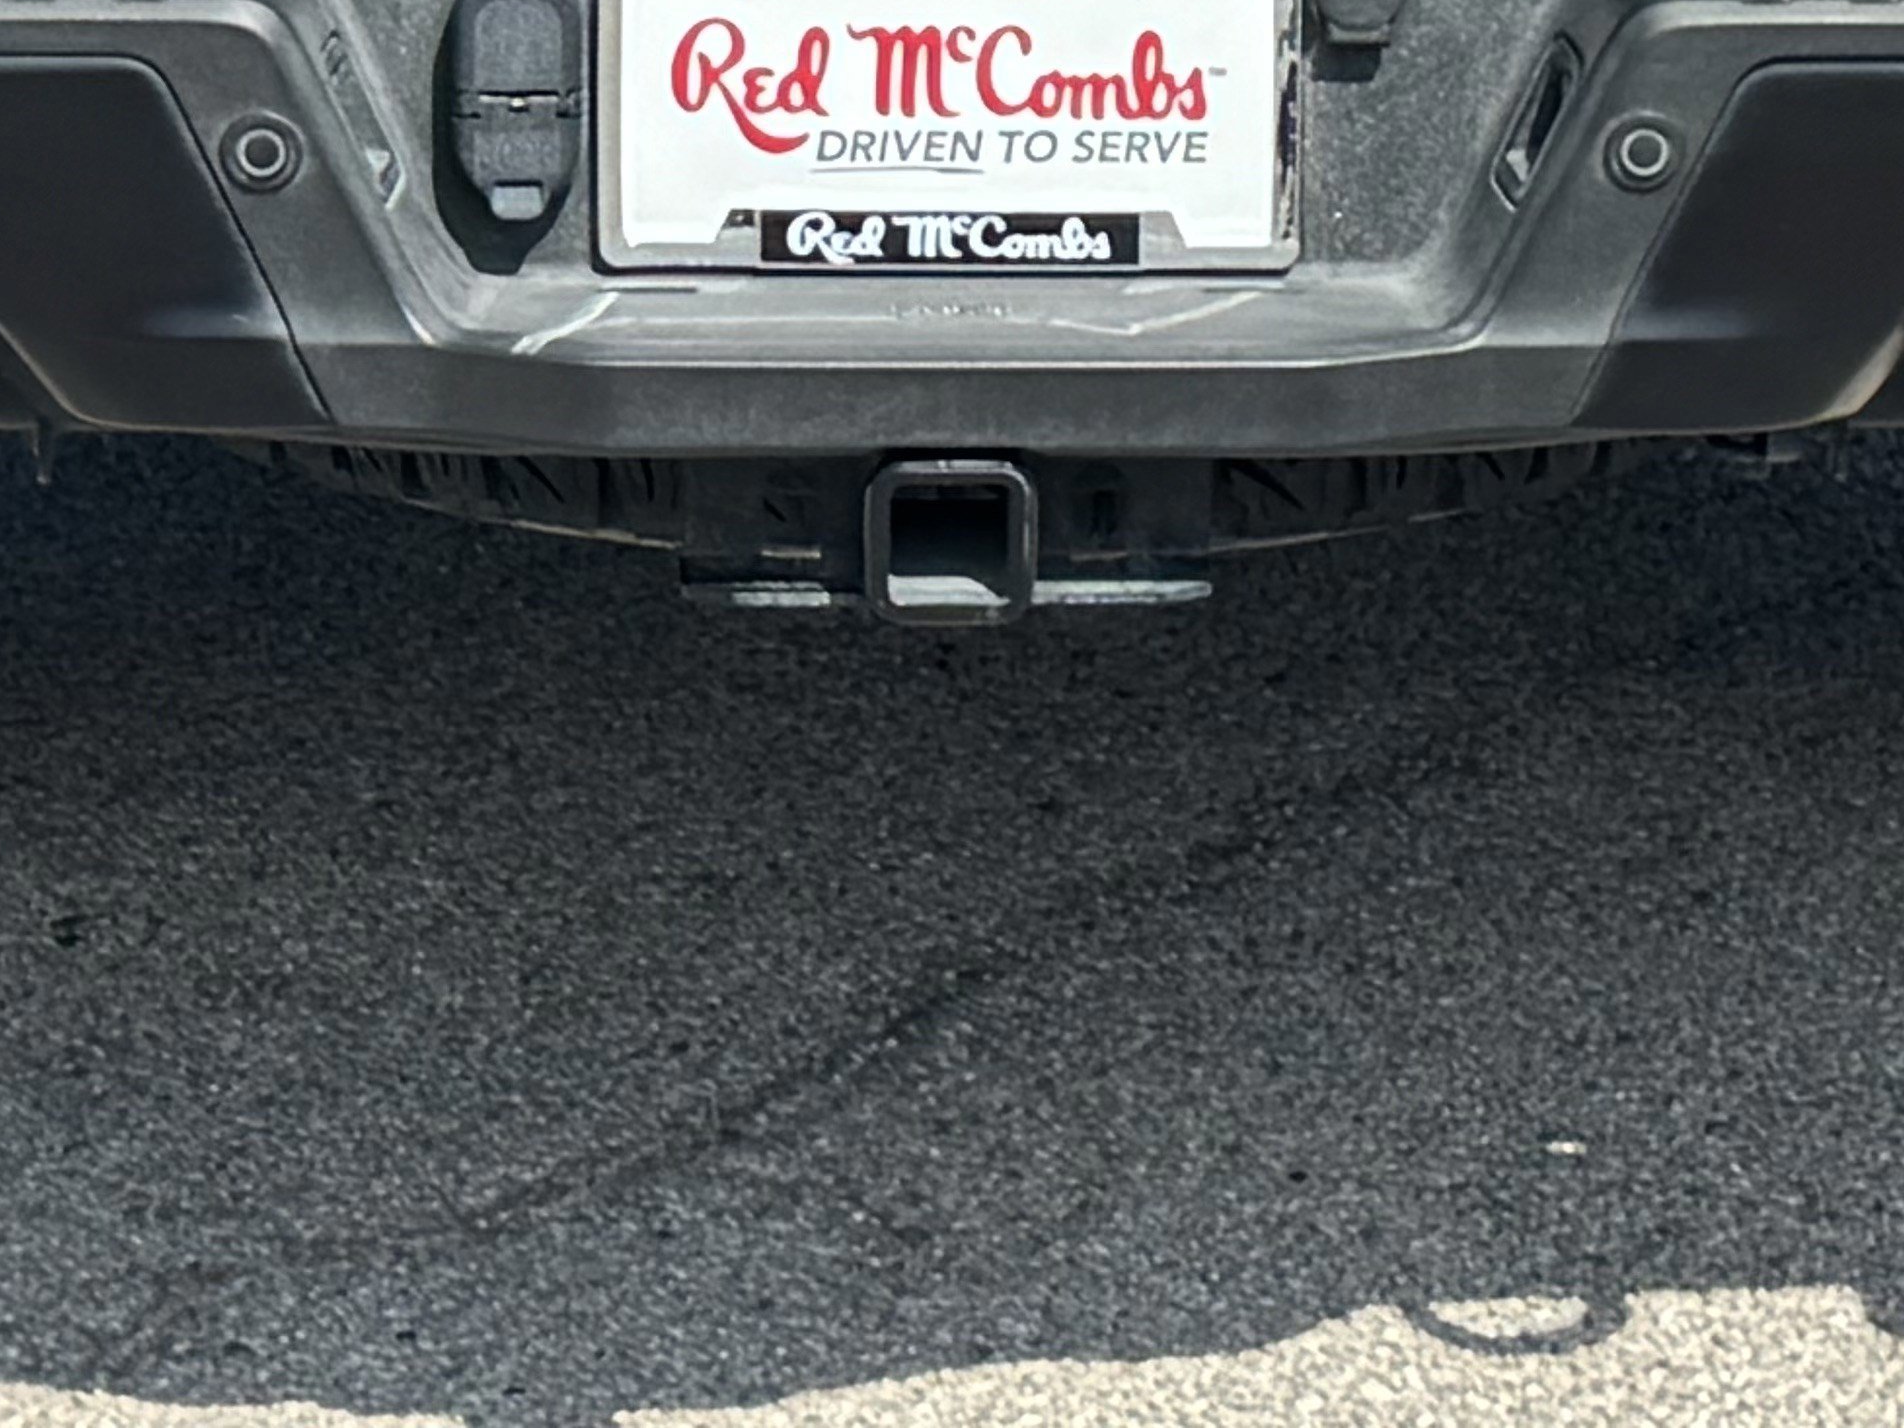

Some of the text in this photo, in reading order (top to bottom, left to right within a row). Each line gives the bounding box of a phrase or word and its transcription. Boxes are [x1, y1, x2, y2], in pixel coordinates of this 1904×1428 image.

[670, 16, 831, 155] Red
[815, 129, 1209, 164] DRIVEN TO SERVE
[786, 210, 1111, 264] Red McCombs
